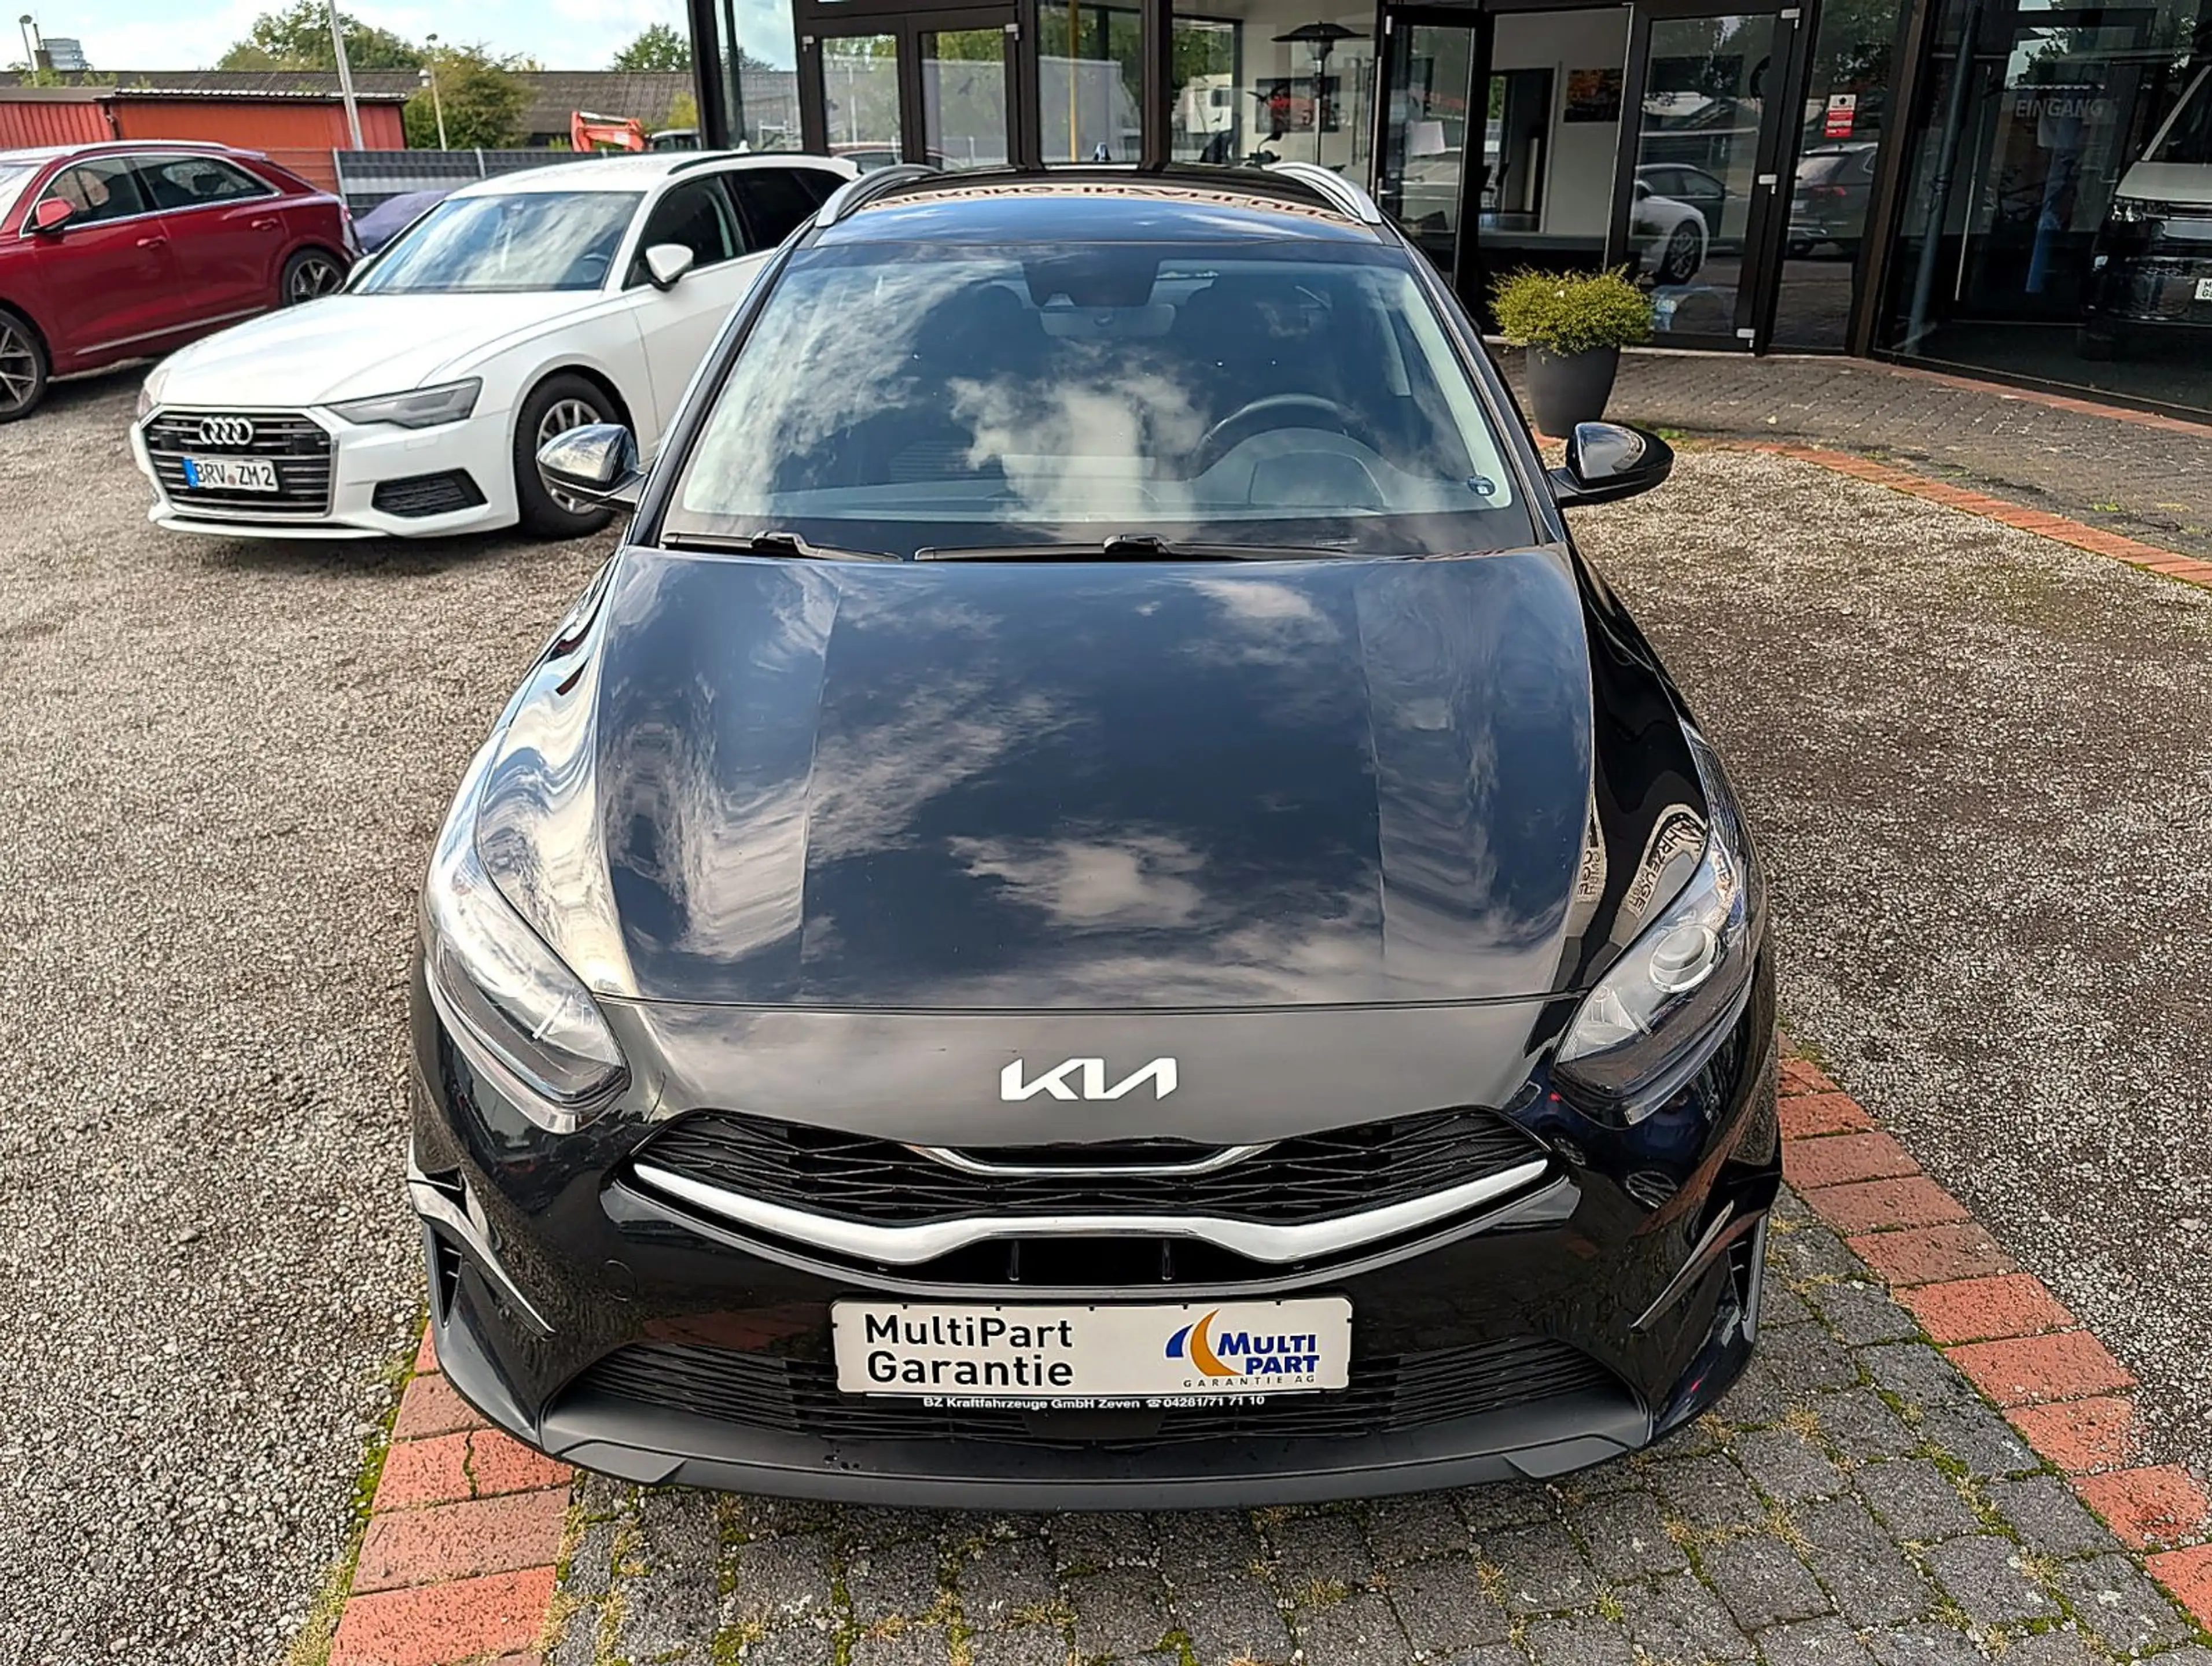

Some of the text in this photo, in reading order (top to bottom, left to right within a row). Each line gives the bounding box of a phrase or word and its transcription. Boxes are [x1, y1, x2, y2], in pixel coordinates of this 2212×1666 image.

[2016, 98, 2103, 117] EINGANG
[194, 463, 225, 484] BRV
[1001, 1057, 1177, 1100] KIA
[865, 1313, 1073, 1348] MultiPart
[1217, 1332, 1316, 1356] MULTI
[867, 1350, 1073, 1387] Garantie
[1245, 1355, 1320, 1375] PART
[1183, 1374, 1315, 1388] GARANTIE AG
[923, 1397, 944, 1408] BZ
[947, 1398, 1048, 1411] Kraftfahrzeuge
[1051, 1399, 1095, 1409] GmbH
[1098, 1399, 1140, 1409] Zeven
[1229, 1396, 1243, 1406] 71
[1249, 1396, 1265, 1406] 10
